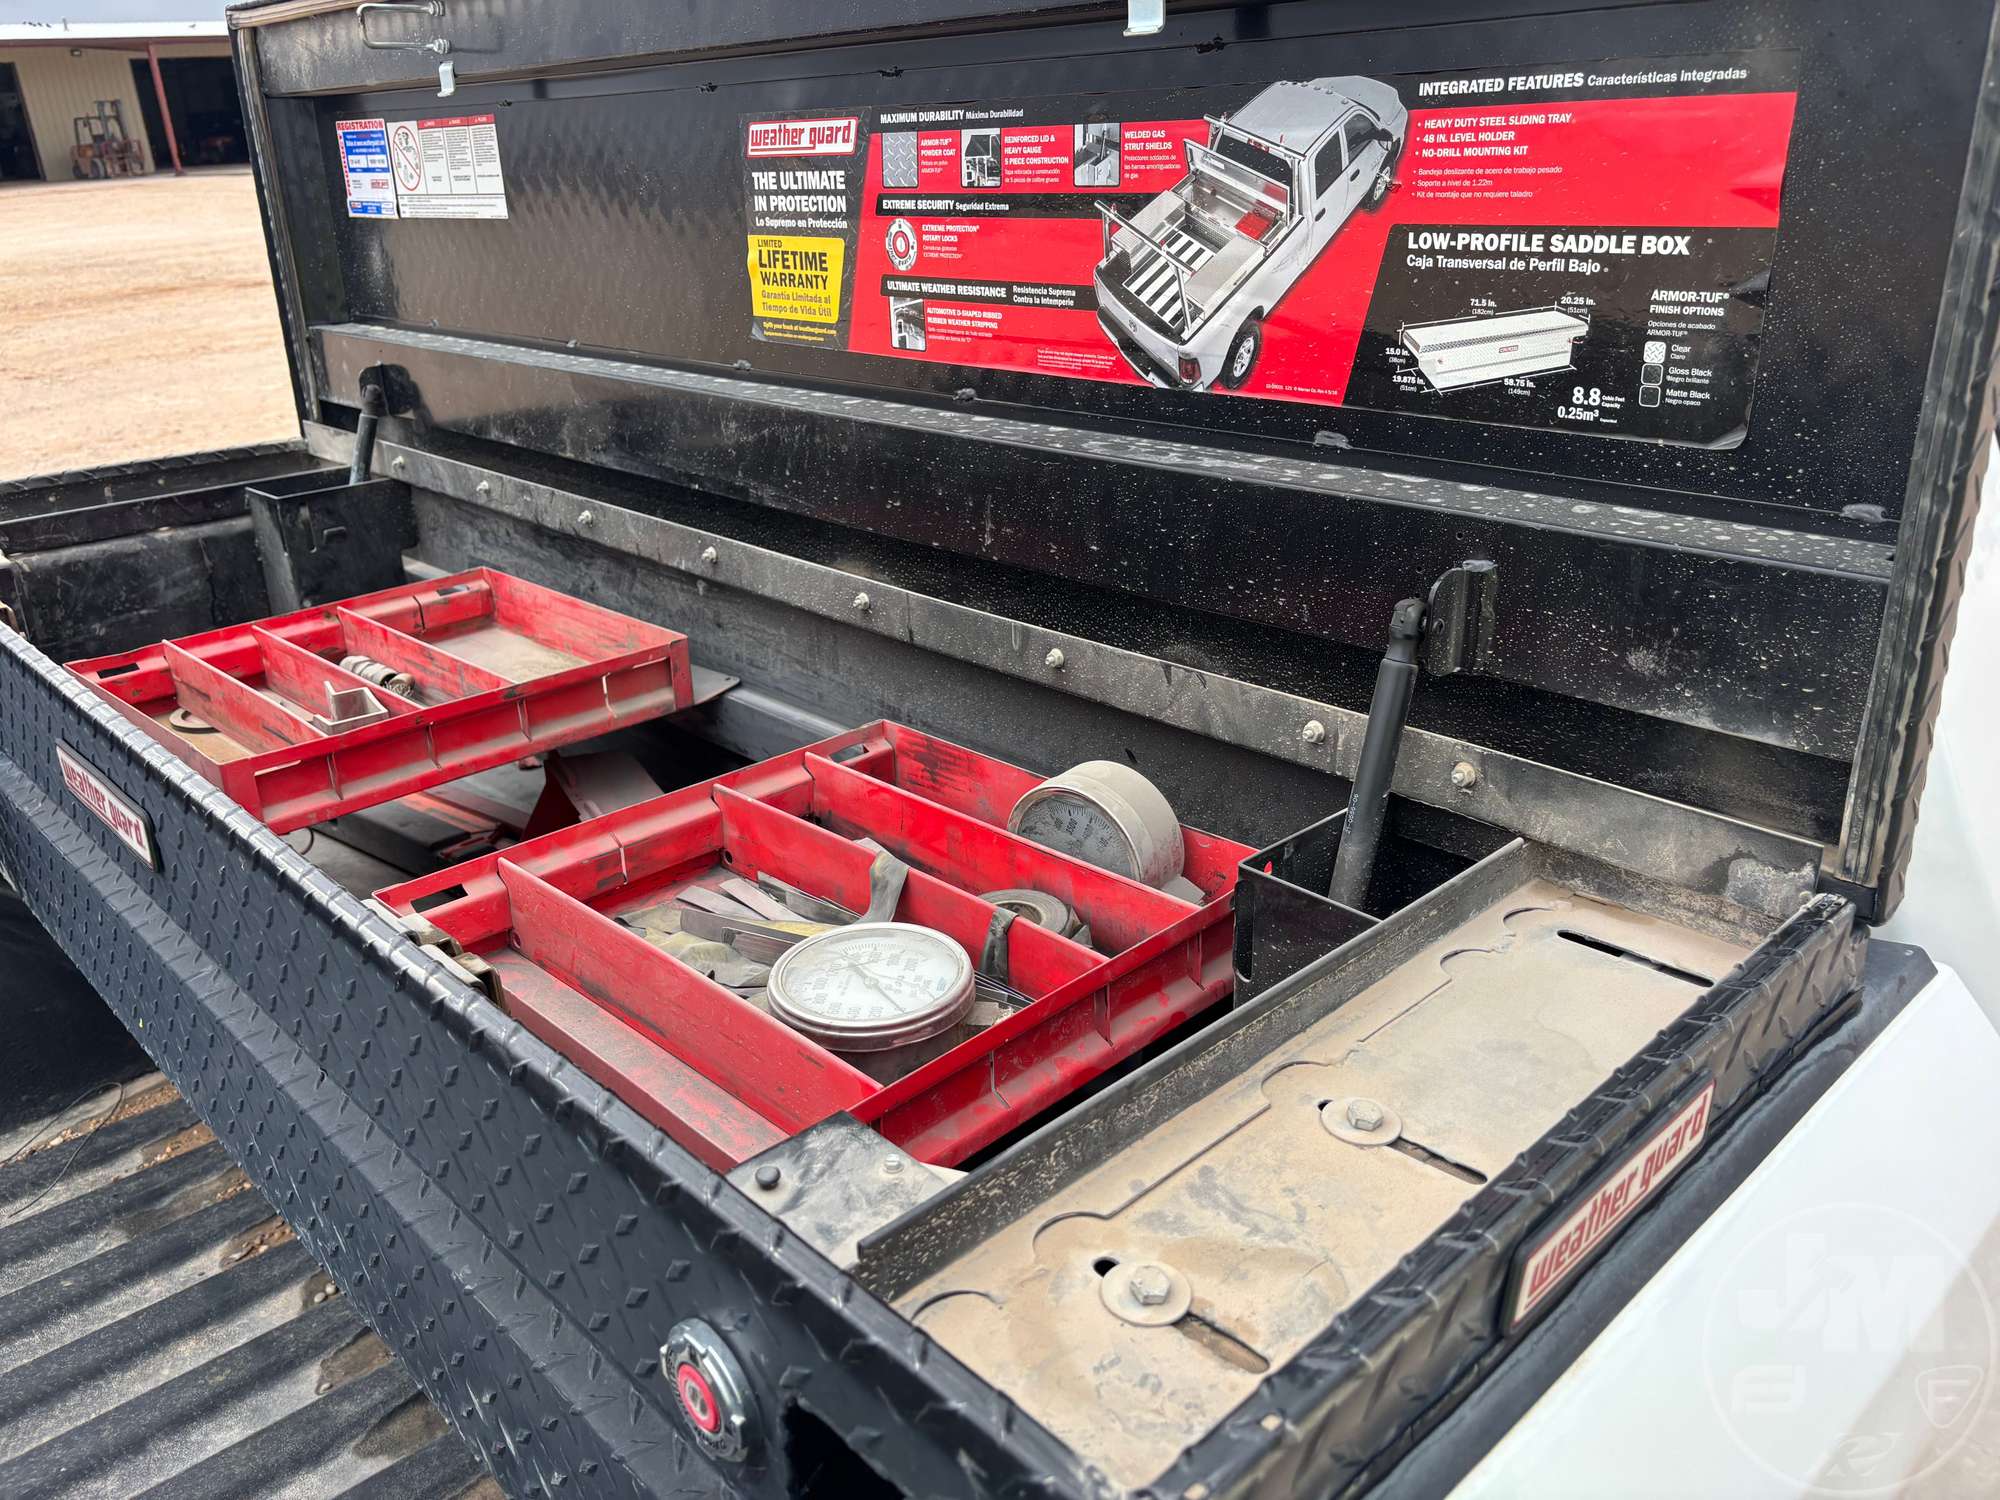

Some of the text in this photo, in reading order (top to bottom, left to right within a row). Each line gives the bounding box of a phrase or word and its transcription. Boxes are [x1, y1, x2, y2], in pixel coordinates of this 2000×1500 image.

[1418, 78, 1505, 97] INTEGRATED
[1508, 72, 1584, 91] FEATURES
[1587, 71, 1678, 87] Características
[880, 108, 1024, 124] MAXIMUM DURABILITY Máxima Durabilidad
[1424, 112, 1572, 129] HEAVY DUTY STEEL SLIDING TRAY
[337, 119, 385, 131] REGISTRATION
[750, 120, 851, 150] weather guard
[1124, 129, 1166, 138] WELDED GAS
[1422, 131, 1515, 143] 48 IN. LEVEL HOLDER
[1004, 135, 1039, 144] REINFORCED
[1004, 146, 1042, 155] HEAVY GAUGE
[1124, 141, 1172, 150] STRUT SHIELDS
[920, 148, 956, 157] POWDER COAT
[1422, 145, 1528, 158] NO-DRILL MOUNTING KIT
[1009, 157, 1026, 165] PIECE
[1026, 156, 1068, 165] CONSTRUCTION
[1418, 168, 1443, 176] Bandeja
[1513, 166, 1536, 175] trabajo
[1537, 166, 1563, 175] pesado
[751, 170, 846, 190] THE ULTIMATE
[1416, 179, 1441, 188] Soporte
[1447, 179, 1462, 187] nivel
[1462, 179, 1471, 187] de
[1472, 179, 1493, 187] 1.22m
[1435, 191, 1460, 199] montaje
[1482, 191, 1509, 199] requiere
[1510, 190, 1533, 198] taladro
[754, 195, 847, 212] IN PROTECTION
[882, 199, 1010, 212] EXTREME SECURITY Seguridad Extrema
[756, 216, 848, 229] Lo Supremo en Protección
[922, 224, 946, 232] EXTREME
[922, 234, 941, 242] ROTARY
[757, 239, 782, 248] LIMITED
[1407, 231, 1691, 256] LOW-PROFILE SADDLE BOX
[758, 249, 829, 272] LIFETIME
[1406, 254, 1601, 275] Caja Transversal de Perfil Bajo
[760, 271, 828, 290] WARRANTY
[887, 280, 1007, 298] ULTIMATE WEATHER RESISTANCE
[1013, 285, 1076, 297] Resistencia Suprema
[792, 291, 823, 304] Limitada
[824, 294, 831, 304] al
[1013, 295, 1033, 304] Contra
[1034, 296, 1040, 304] la
[1470, 298, 1486, 307] 71.5
[1560, 296, 1584, 305] 20.25
[762, 302, 832, 317] Tiempo de Vida Útil
[927, 307, 956, 316] AUTOMOTIVE
[1471, 307, 1494, 317] (182cm)
[1567, 306, 1588, 315] (51cm)
[1649, 305, 1725, 317] FINISH OPTIONS
[927, 316, 947, 325] RUBBER
[947, 318, 971, 326] WEATHER
[1647, 320, 1677, 329] Opciones
[1687, 322, 1716, 330] acabado
[1385, 347, 1400, 357] 15.0
[1671, 344, 1692, 353] Clear
[1668, 366, 1713, 377] Gloss Black
[1392, 375, 1417, 385] 19.875
[1503, 378, 1526, 388] 58.75
[1666, 375, 1710, 384] Negro brillante
[1571, 386, 1601, 406] 8.8
[1665, 389, 1711, 400] Matte Black
[1665, 397, 1702, 407] Negro opaco
[62, 759, 145, 849] weather guard
[1527, 1094, 1709, 1299] weather guard
